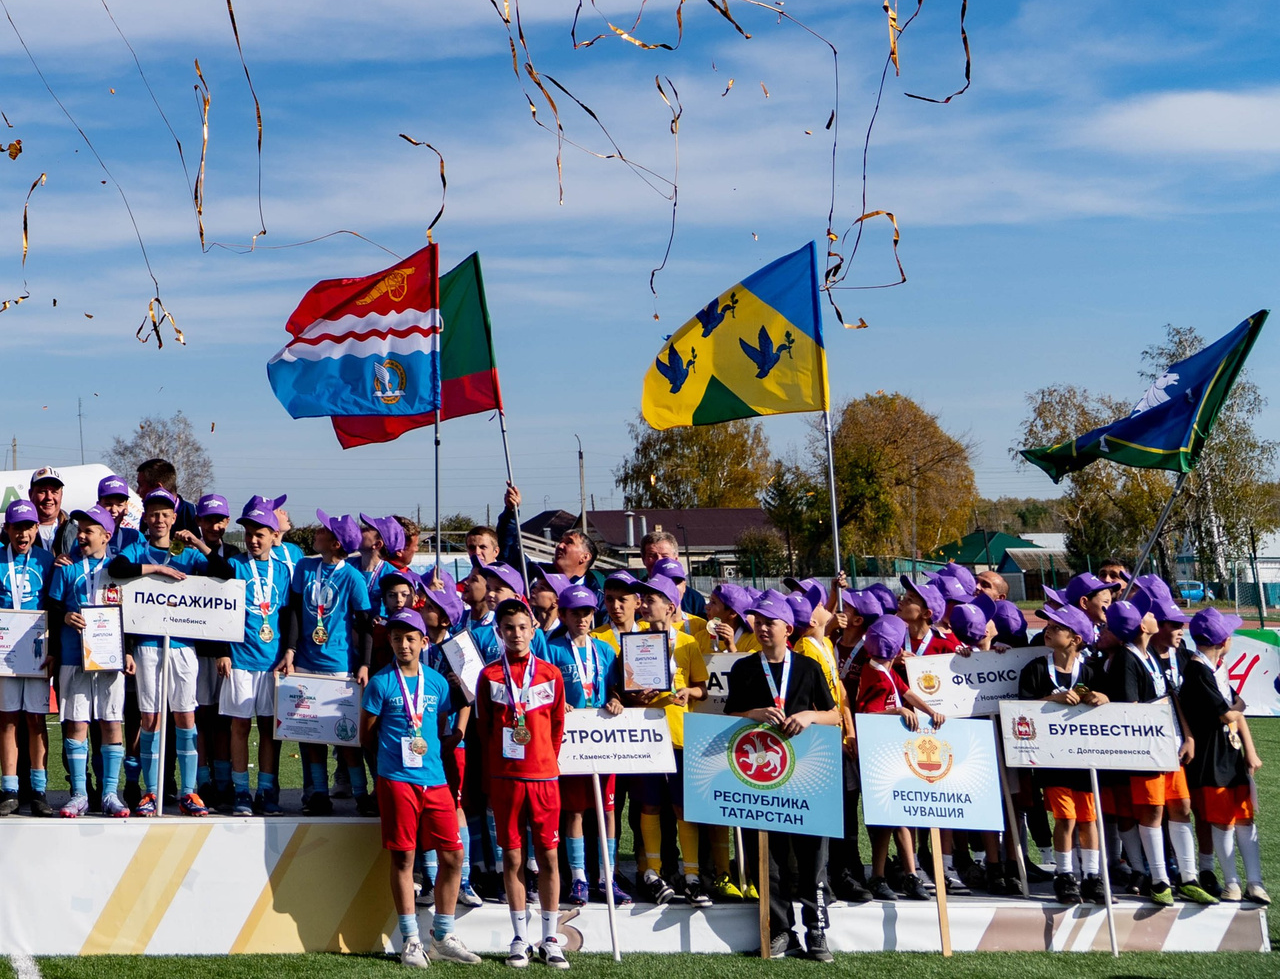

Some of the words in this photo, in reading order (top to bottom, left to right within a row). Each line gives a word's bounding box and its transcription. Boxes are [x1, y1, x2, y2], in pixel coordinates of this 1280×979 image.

[134, 591, 237, 611] ПАССАЖИРЫ
[169, 616, 207, 625] Челябинск
[952, 673, 976, 686] ФК
[1048, 723, 1166, 737] БУРЕВЕСТНИК
[579, 752, 652, 761] Каменск-Уральский
[1076, 747, 1151, 756] Долгодеревенское
[713, 790, 810, 811] РЕСПУБЛИКА
[893, 790, 972, 804] РЕСПУБЛИКА
[719, 806, 804, 825] ТАТАРСТАН
[903, 805, 964, 819] ЧУВАШИЯ
